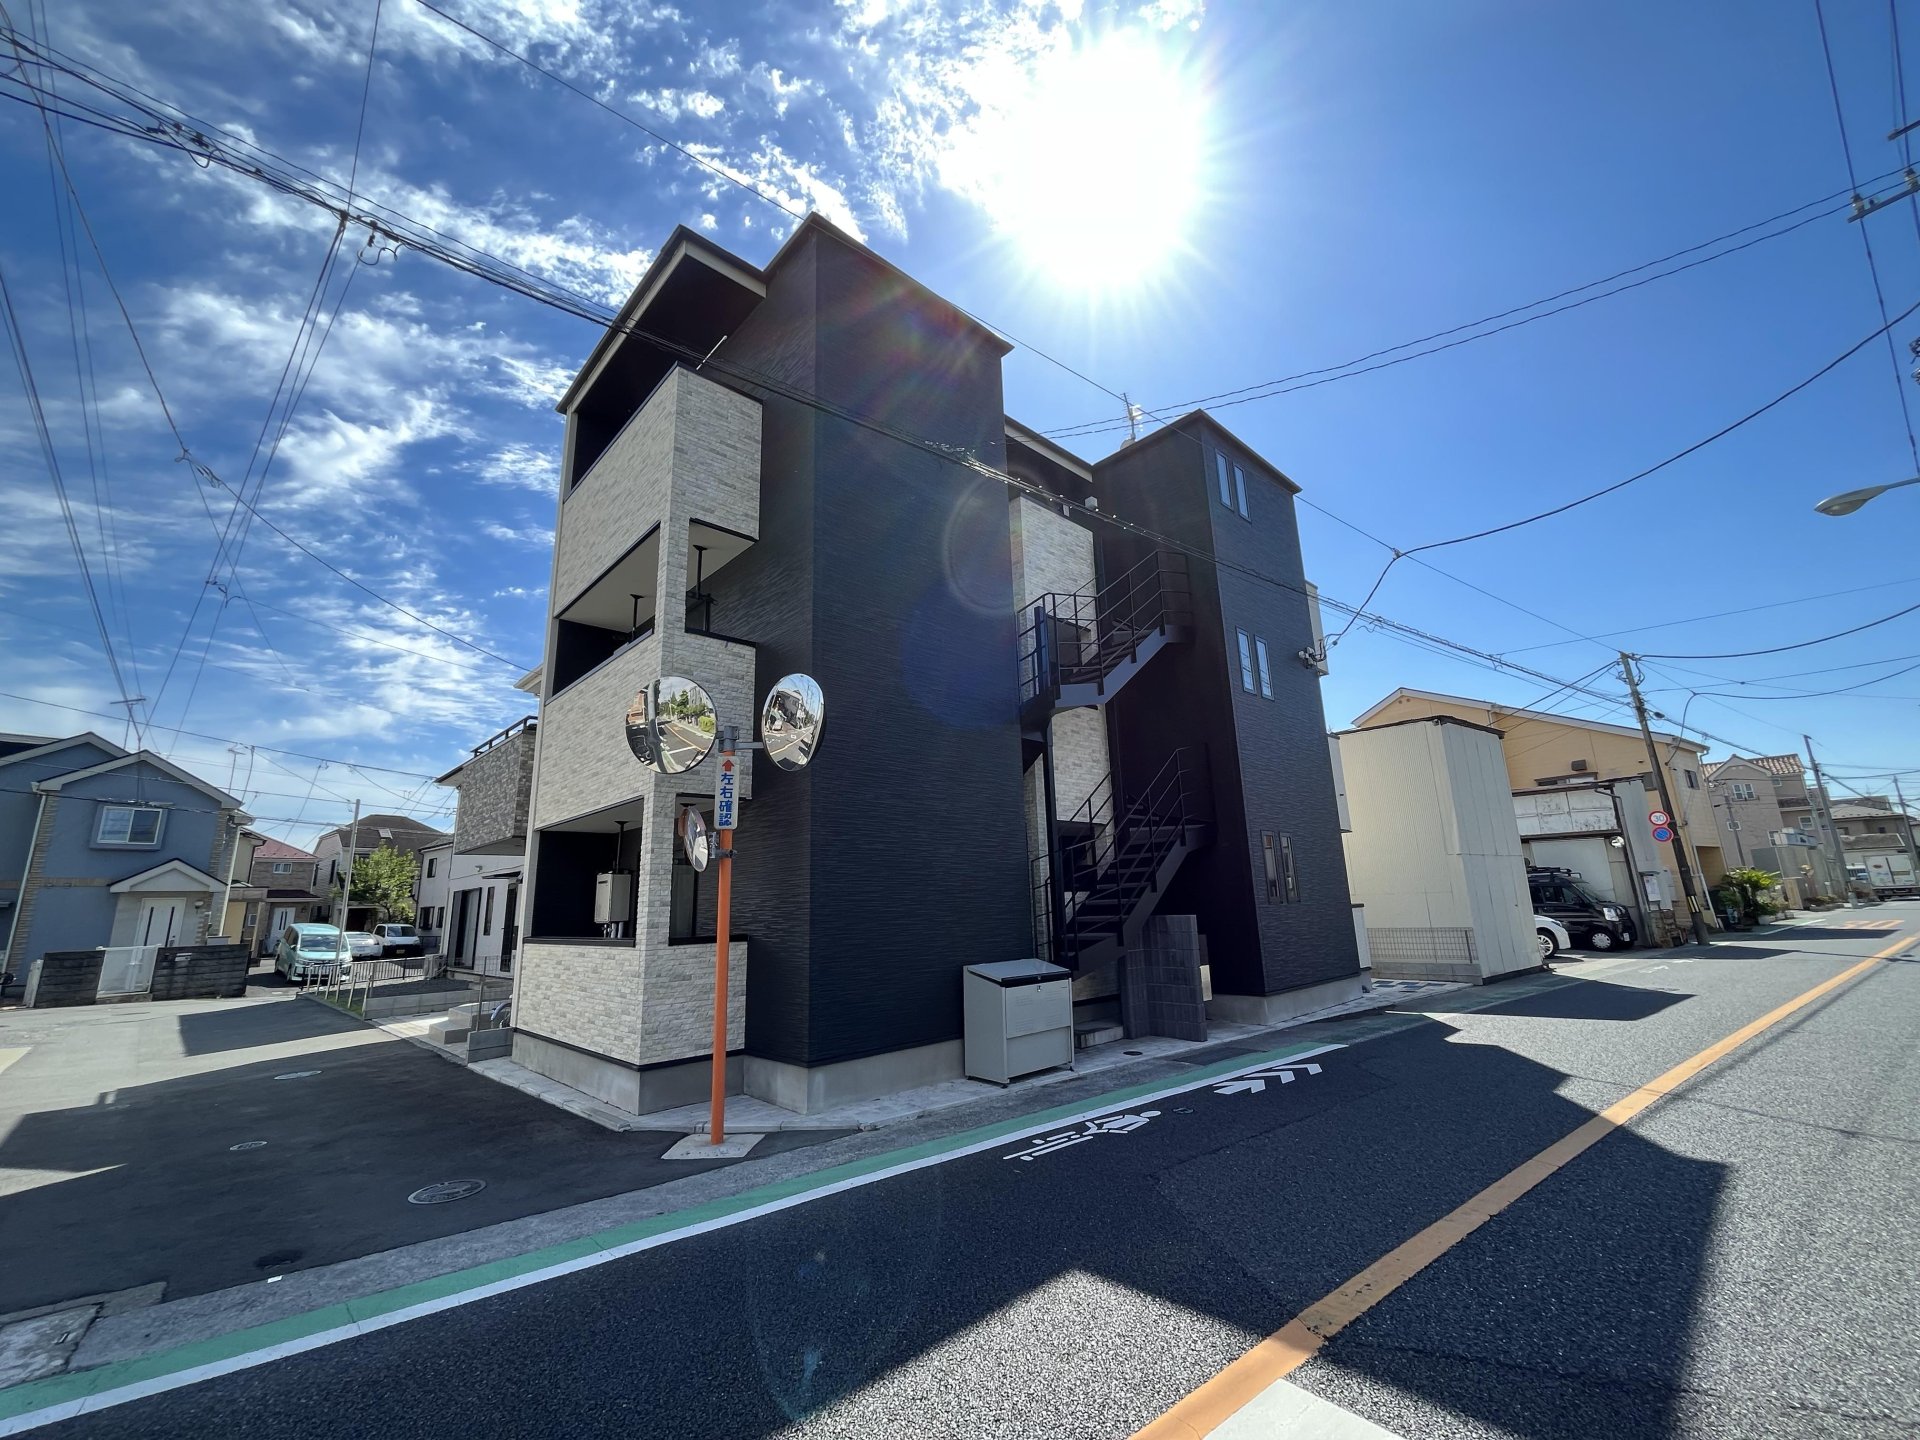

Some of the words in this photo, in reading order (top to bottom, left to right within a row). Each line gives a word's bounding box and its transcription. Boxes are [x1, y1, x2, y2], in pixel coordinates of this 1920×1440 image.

[719, 772, 734, 827] 左右確認
[1653, 814, 1665, 822] 30
